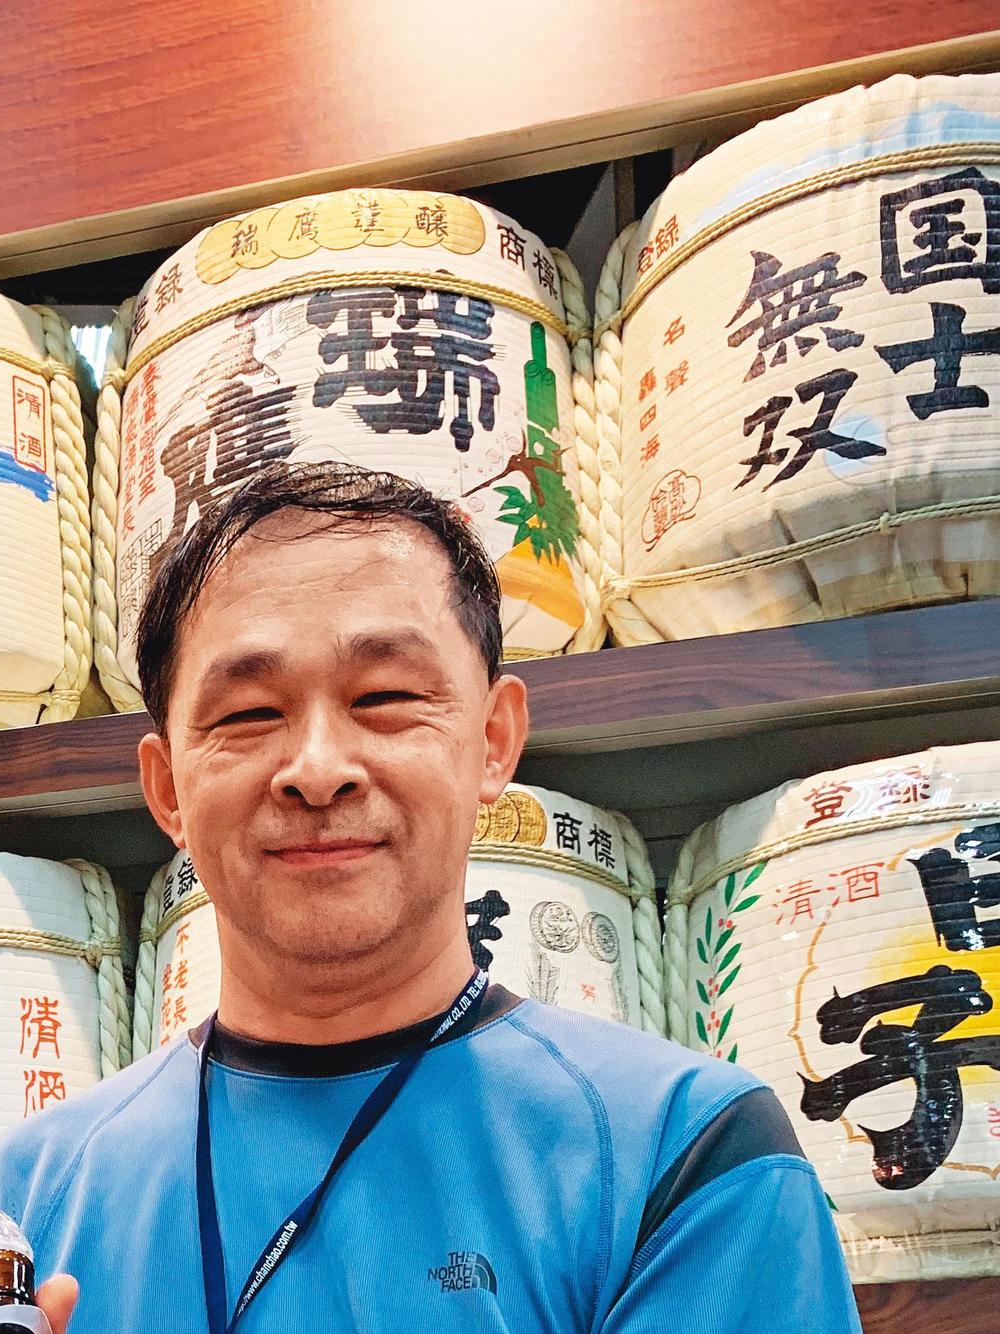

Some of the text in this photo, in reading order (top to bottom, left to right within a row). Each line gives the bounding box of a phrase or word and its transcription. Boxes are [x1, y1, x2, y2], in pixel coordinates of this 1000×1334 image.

[497, 223, 560, 300] 商標
[873, 167, 1000, 420] 国士
[725, 251, 886, 491] 無双
[16, 387, 43, 458] 清酒
[552, 811, 616, 870] 商標
[772, 861, 886, 927] 清酒
[428, 1263, 473, 1281] NORTH
[441, 1275, 472, 1293] FACE
[448, 1250, 472, 1266] THE
